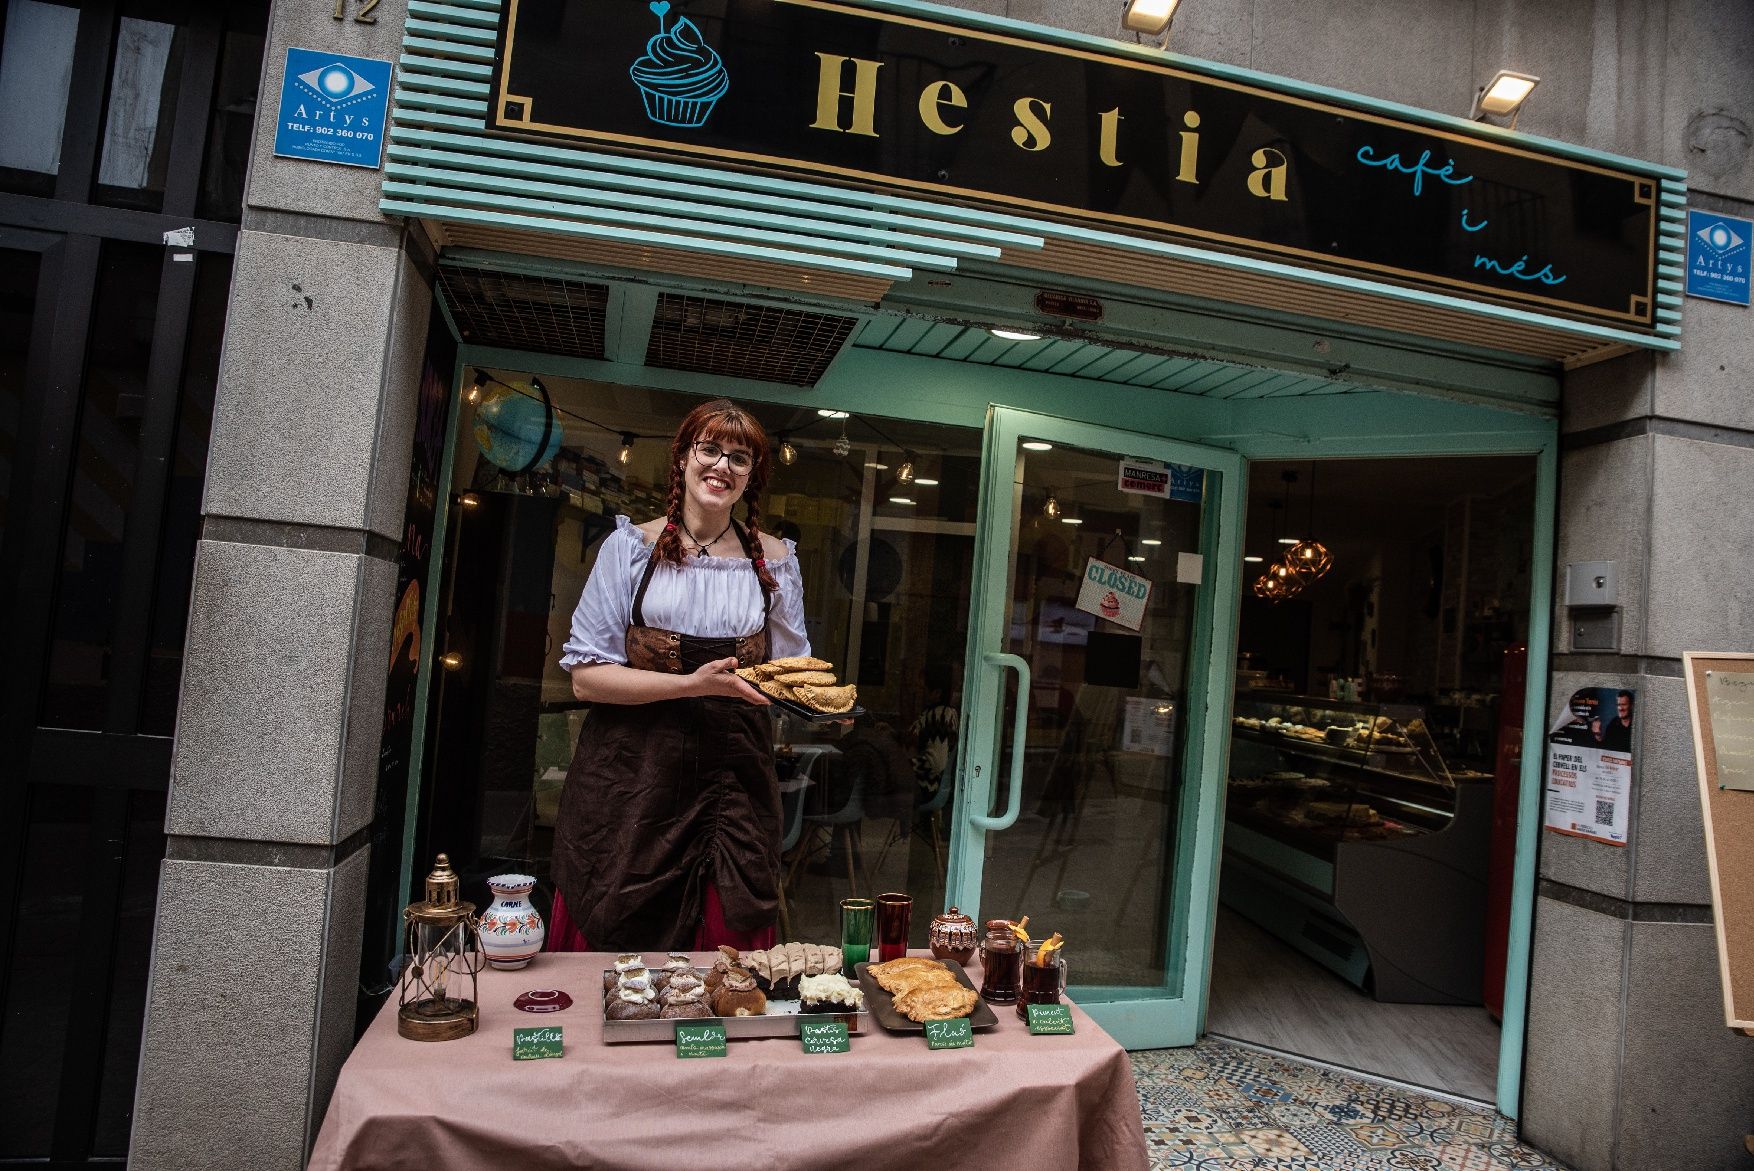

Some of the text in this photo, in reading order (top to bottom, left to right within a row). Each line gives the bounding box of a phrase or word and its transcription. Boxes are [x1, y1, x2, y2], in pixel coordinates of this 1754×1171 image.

[293, 104, 369, 127] Artys
[808, 51, 1288, 201] Hestia
[287, 122, 374, 141] TELF: 902 360 070
[1461, 208, 1488, 232] i
[1474, 254, 1567, 285] més
[1696, 254, 1743, 273] Artys
[1088, 564, 1147, 600] CLOSED
